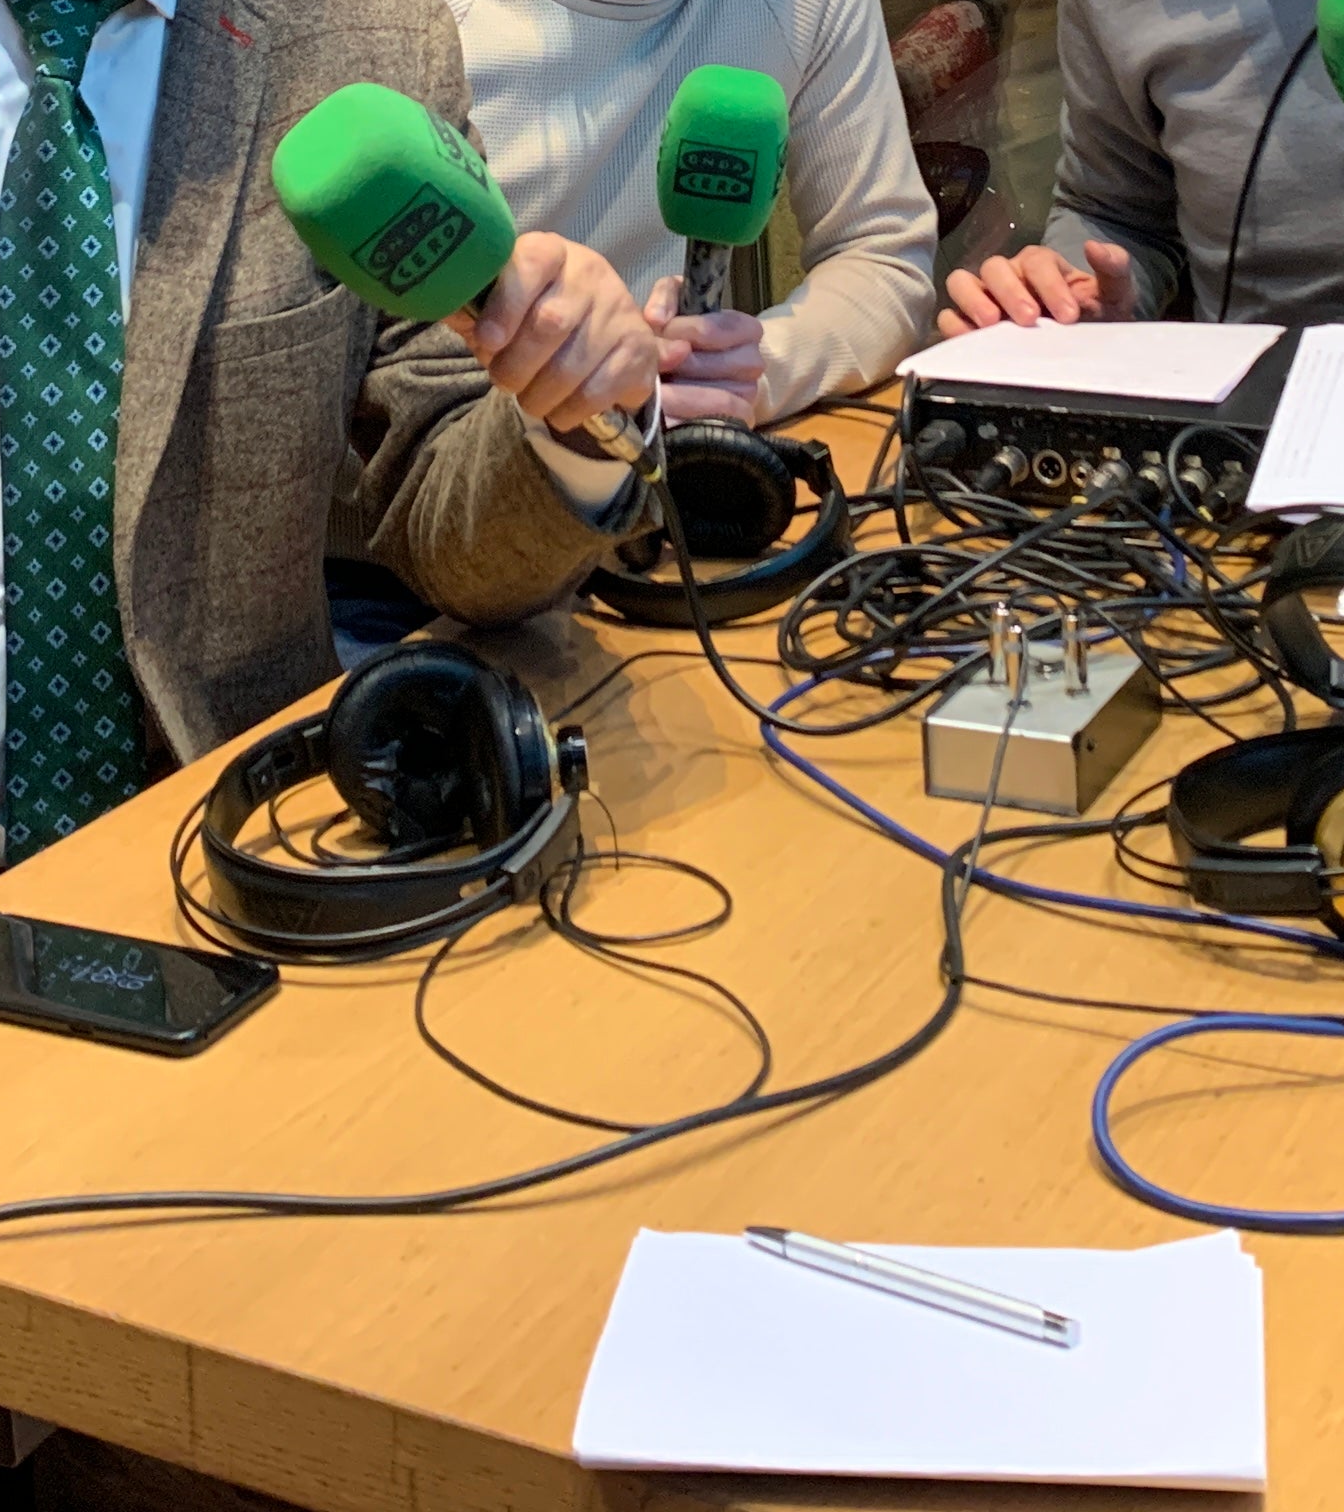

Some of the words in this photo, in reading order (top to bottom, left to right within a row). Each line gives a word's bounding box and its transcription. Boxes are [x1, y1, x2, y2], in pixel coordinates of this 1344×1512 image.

[688, 153, 744, 172] ONDA
[687, 175, 742, 194] CERO
[399, 225, 455, 279] CERO
